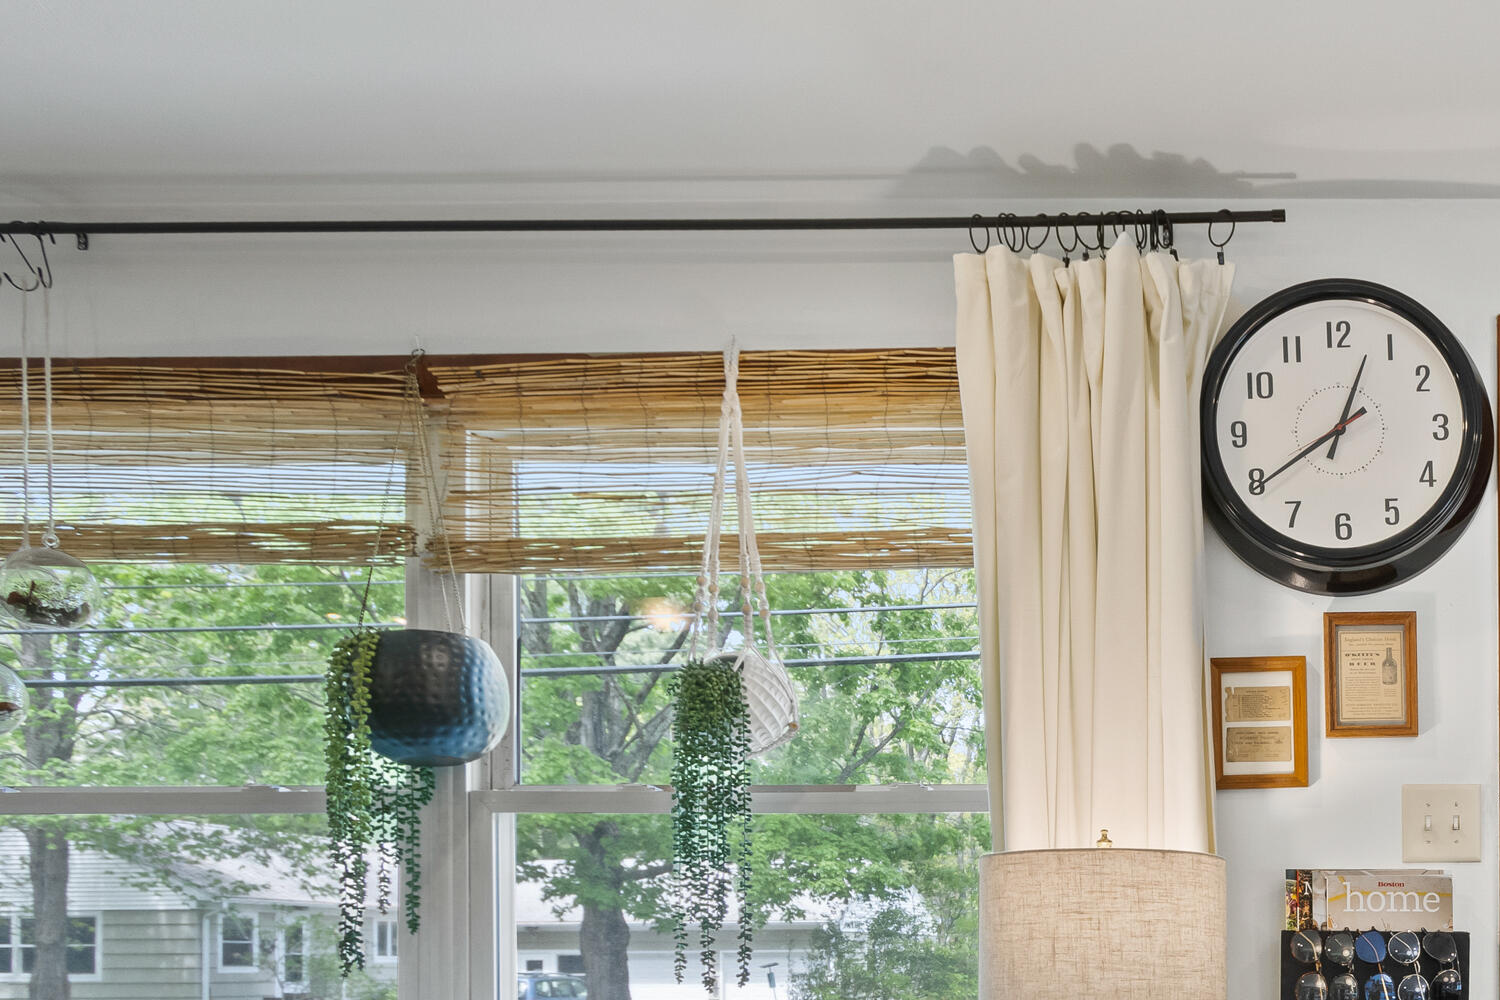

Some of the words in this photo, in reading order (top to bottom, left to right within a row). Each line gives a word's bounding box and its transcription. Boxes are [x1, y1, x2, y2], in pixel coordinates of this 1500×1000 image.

[1327, 321, 1350, 348] 12
[1387, 334, 1393, 360] 1
[1283, 336, 1301, 363] 11
[1247, 372, 1273, 399] 10
[1416, 365, 1430, 392] 2
[1231, 421, 1247, 448] 9
[1433, 414, 1449, 440] 3
[1249, 468, 1265, 495] 8
[1419, 461, 1437, 487] 4
[1285, 501, 1301, 528] 7
[1385, 498, 1399, 525] 5
[1335, 513, 1352, 540] 6
[1342, 882, 1440, 912] home
